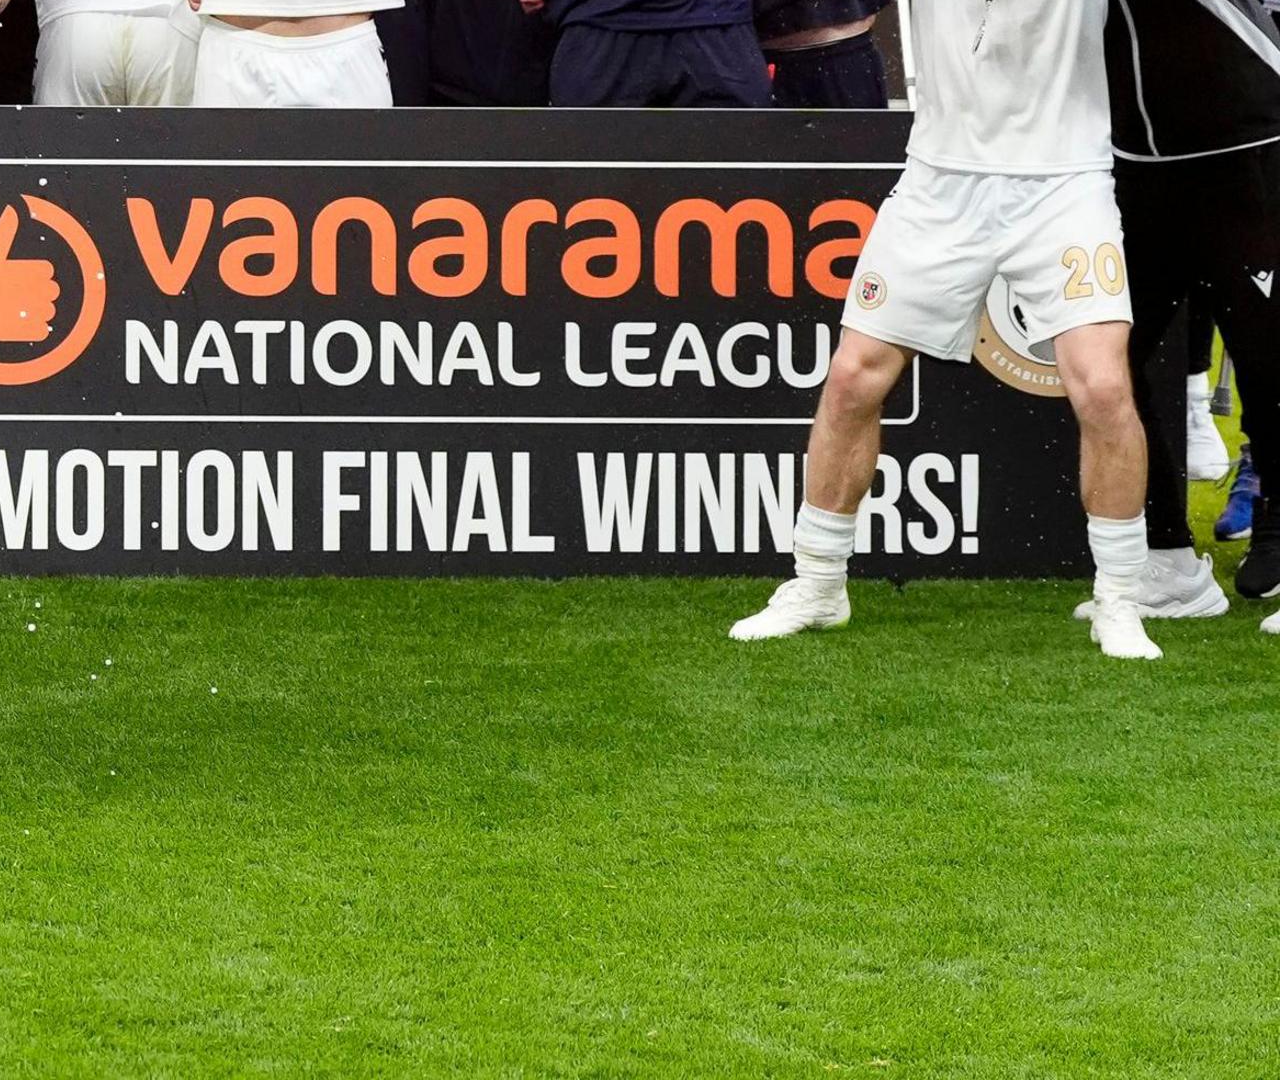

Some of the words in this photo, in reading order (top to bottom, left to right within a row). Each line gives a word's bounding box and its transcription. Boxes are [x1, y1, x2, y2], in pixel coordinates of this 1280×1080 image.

[126, 196, 880, 299] vanarama
[1061, 241, 1125, 300] 20
[125, 320, 540, 387] NATIONAL
[565, 322, 831, 389] LEAGU
[990, 349, 1064, 387] ESTABLIS
[323, 450, 555, 553] FINAL
[576, 452, 981, 555] WINNRS!
